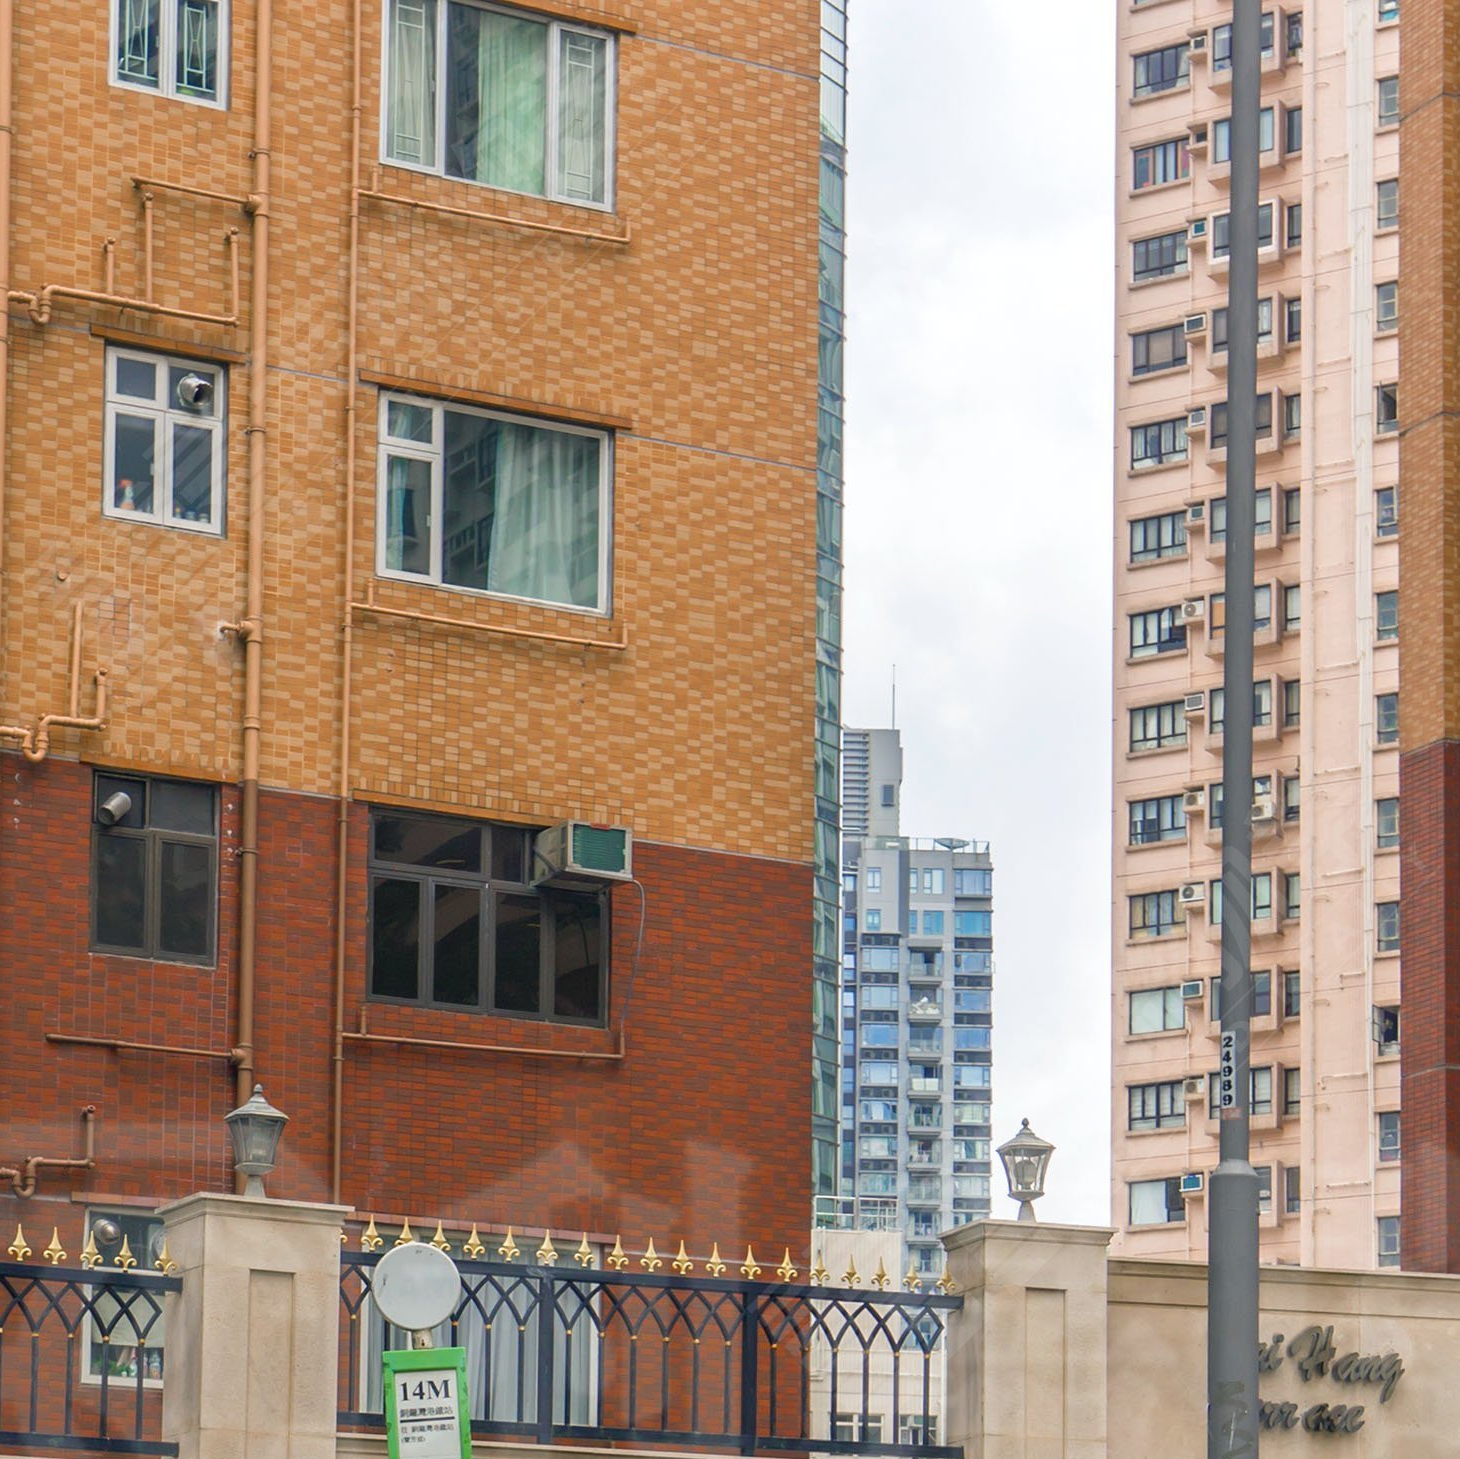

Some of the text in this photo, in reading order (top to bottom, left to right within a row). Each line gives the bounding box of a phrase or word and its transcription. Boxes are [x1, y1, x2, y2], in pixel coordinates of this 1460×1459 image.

[1222, 1035, 1233, 1106] 24989
[400, 1379, 451, 1402] 14M
[1287, 1325, 1406, 1404] Hang
[1259, 1400, 1365, 1433] rrace
